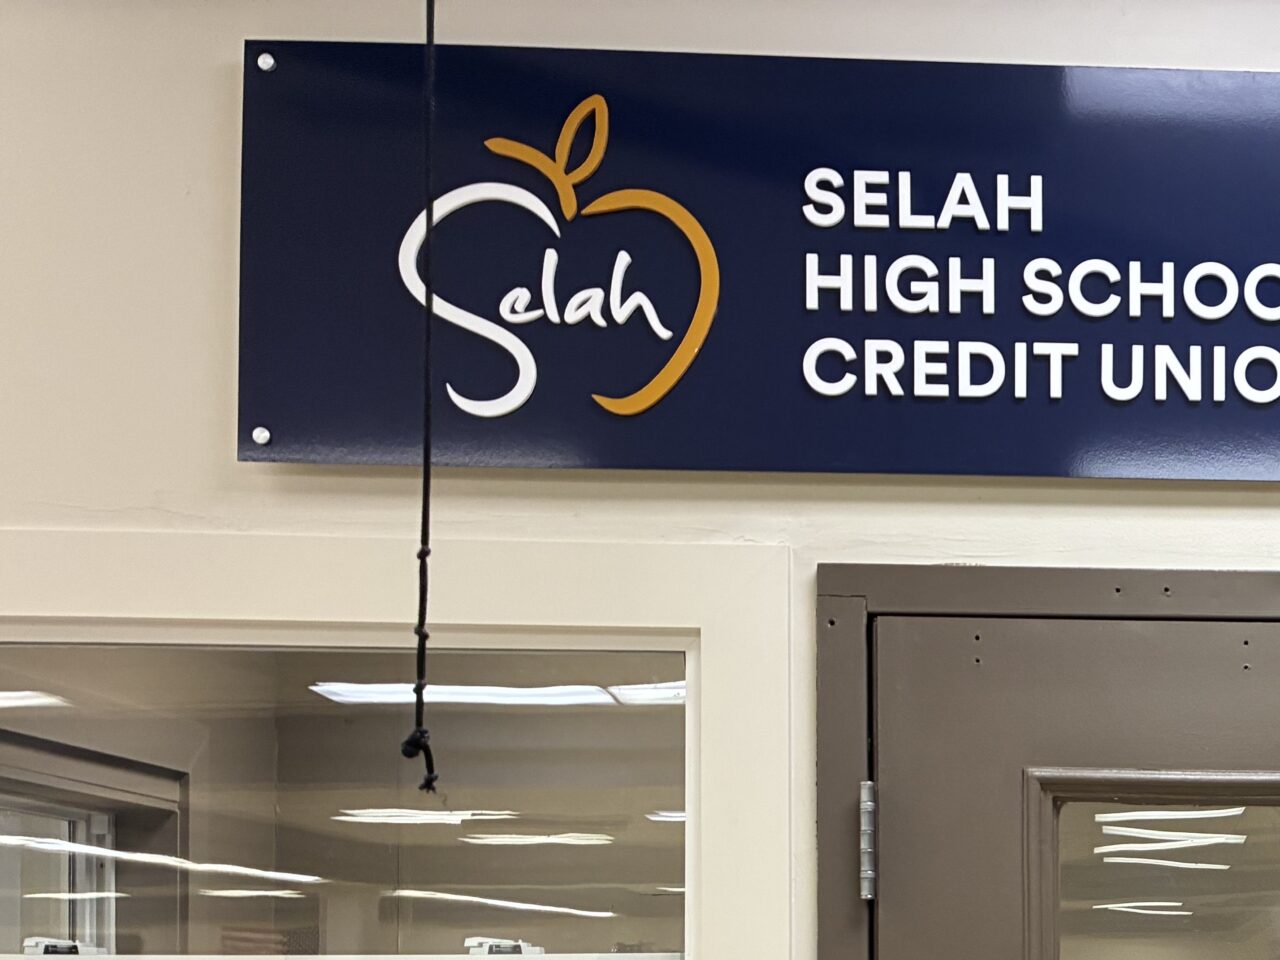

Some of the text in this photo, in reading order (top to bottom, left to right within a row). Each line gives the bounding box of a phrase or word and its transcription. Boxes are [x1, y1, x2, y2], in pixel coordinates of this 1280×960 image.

[803, 167, 1043, 232] SELAH
[398, 182, 673, 418] Selah
[804, 253, 995, 314] HIGH
[803, 337, 1079, 399] CREDIT
